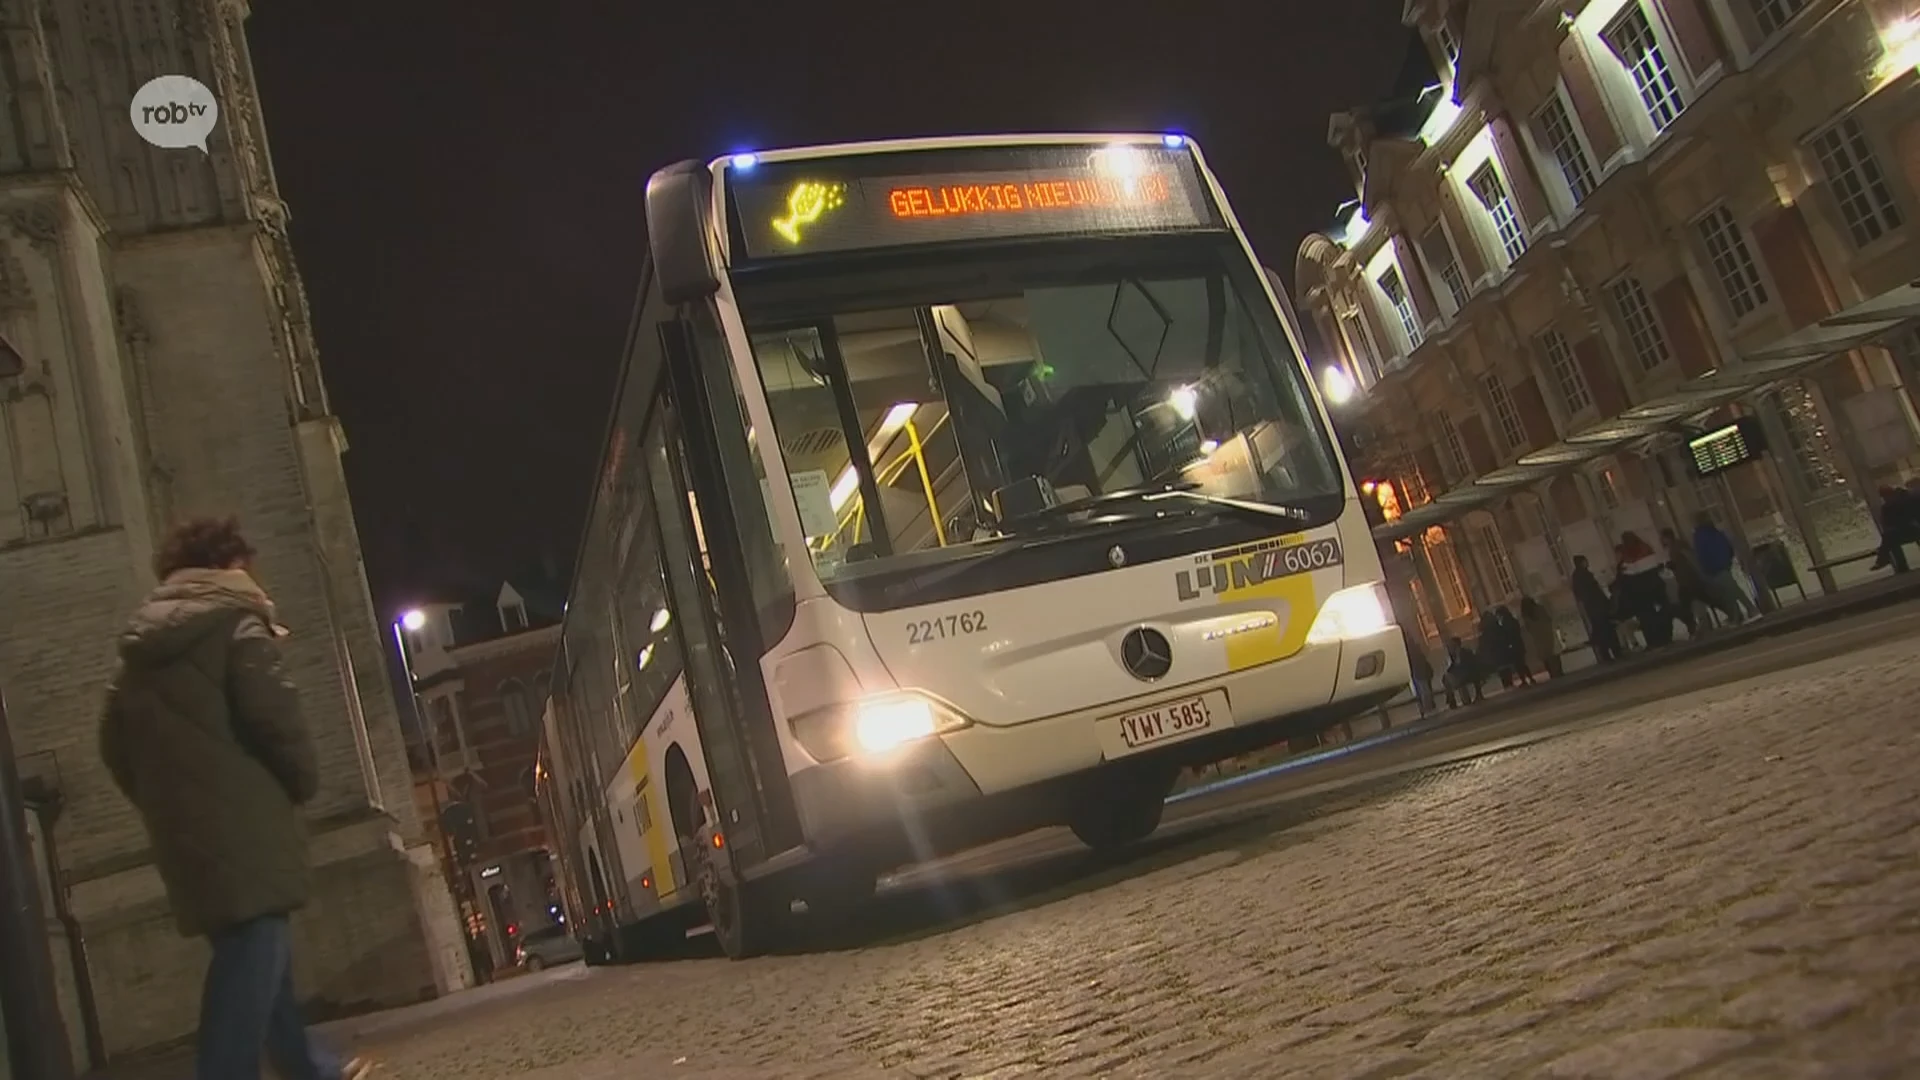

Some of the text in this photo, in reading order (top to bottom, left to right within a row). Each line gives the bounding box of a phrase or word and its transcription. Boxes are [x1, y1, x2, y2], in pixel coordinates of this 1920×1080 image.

[890, 176, 1166, 216] GELUKKIG NIEUWJR!
[1284, 541, 1338, 572] 6062
[906, 610, 988, 645] 221762
